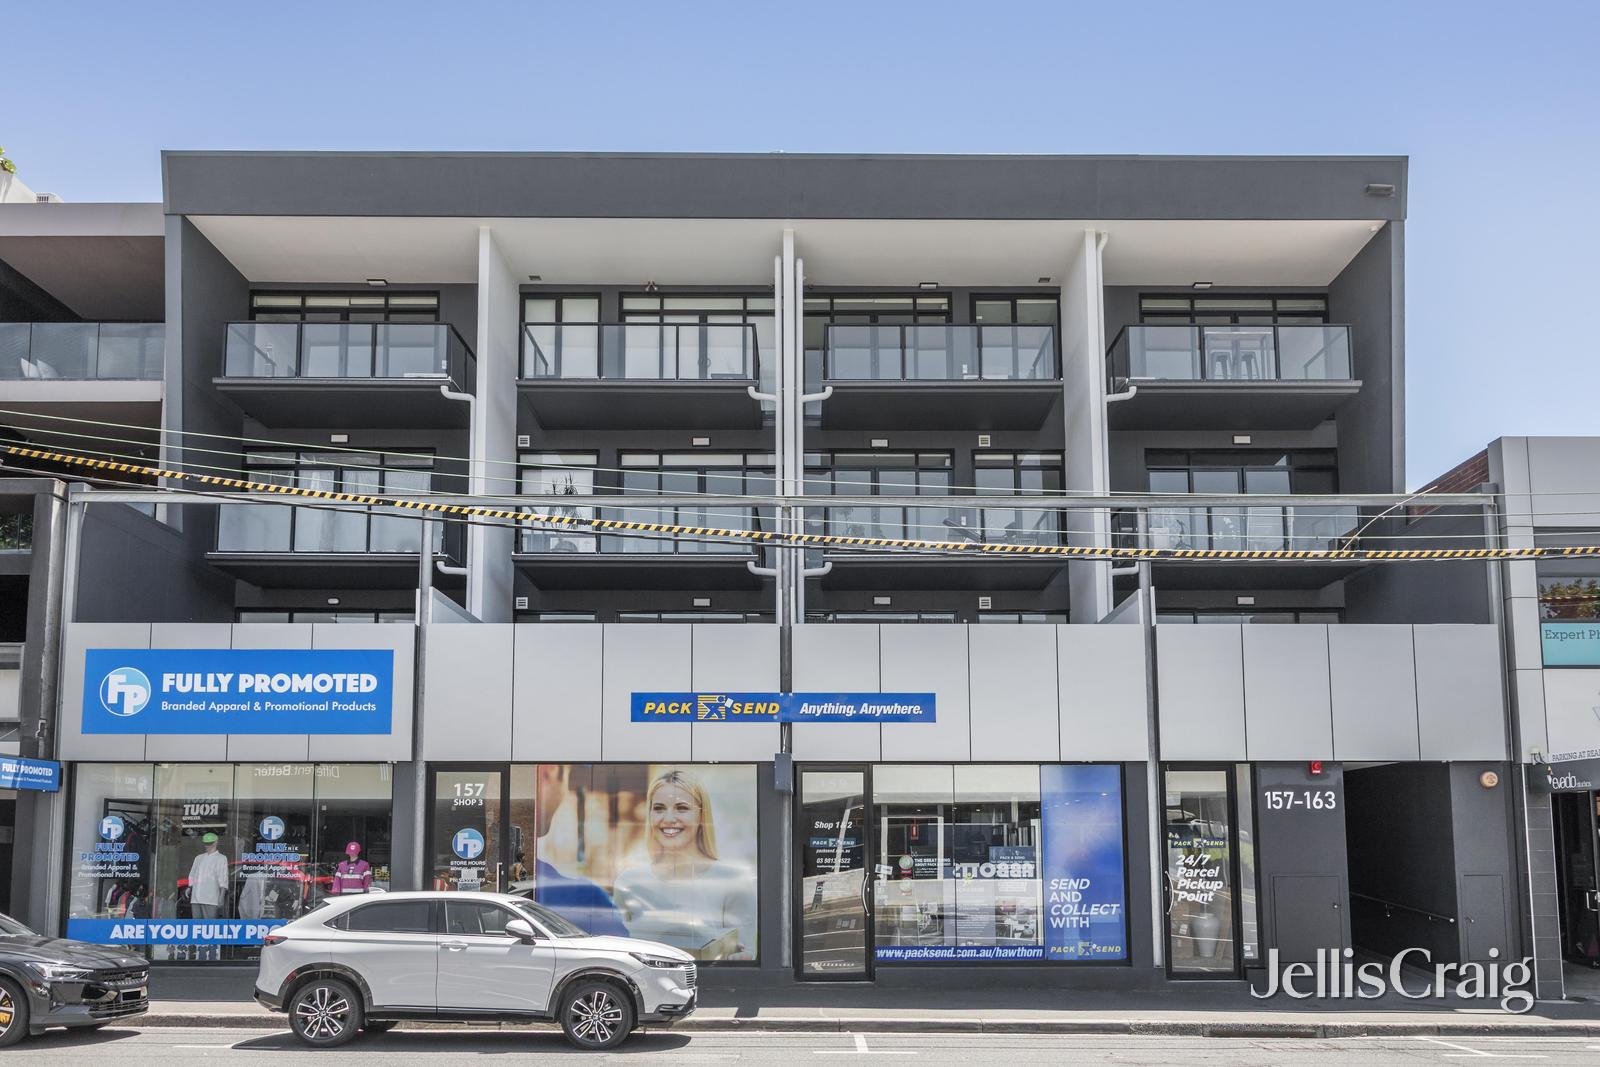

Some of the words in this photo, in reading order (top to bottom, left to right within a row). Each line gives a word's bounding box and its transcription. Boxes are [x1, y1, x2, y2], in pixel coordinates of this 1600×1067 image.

[1545, 630, 1585, 641] Expert
[162, 673, 234, 693] FULLY
[238, 673, 378, 693] PROMOTED
[161, 701, 206, 712] Branded
[209, 701, 251, 715] Apparel
[253, 702, 262, 712] &
[265, 702, 329, 713] Promotional
[331, 702, 377, 713] Products
[644, 702, 692, 714] PACK
[731, 703, 781, 714] SEND
[800, 702, 857, 716] Anything.
[859, 703, 923, 715] Anywhere.
[1552, 753, 1577, 762] PARKING
[2, 763, 20, 773] FULLY
[20, 764, 53, 777] PROMOTED
[454, 783, 484, 797] 157
[1264, 791, 1336, 809] 157-163
[814, 821, 833, 830] Shop
[835, 821, 840, 829] 1
[847, 821, 853, 829] 2
[95, 842, 126, 852] FULLY
[255, 842, 287, 852] FULLY
[81, 852, 140, 862] PROMOTED
[242, 852, 301, 862] PROMOTED
[1176, 854, 1211, 867] 24/7
[269, 864, 293, 872] Apparel
[1176, 866, 1220, 877] Parcel
[1050, 879, 1090, 889] SEND
[1177, 879, 1224, 891] Pickup
[1050, 892, 1082, 902] AND
[1178, 891, 1214, 902] Point
[1051, 904, 1120, 915] COLLECT
[1050, 917, 1090, 928] WITH
[111, 925, 144, 939] ARE
[149, 925, 187, 939] YOU
[193, 925, 241, 939] FULLY
[876, 948, 1043, 958] www.packsend.com.au/hawthorn
